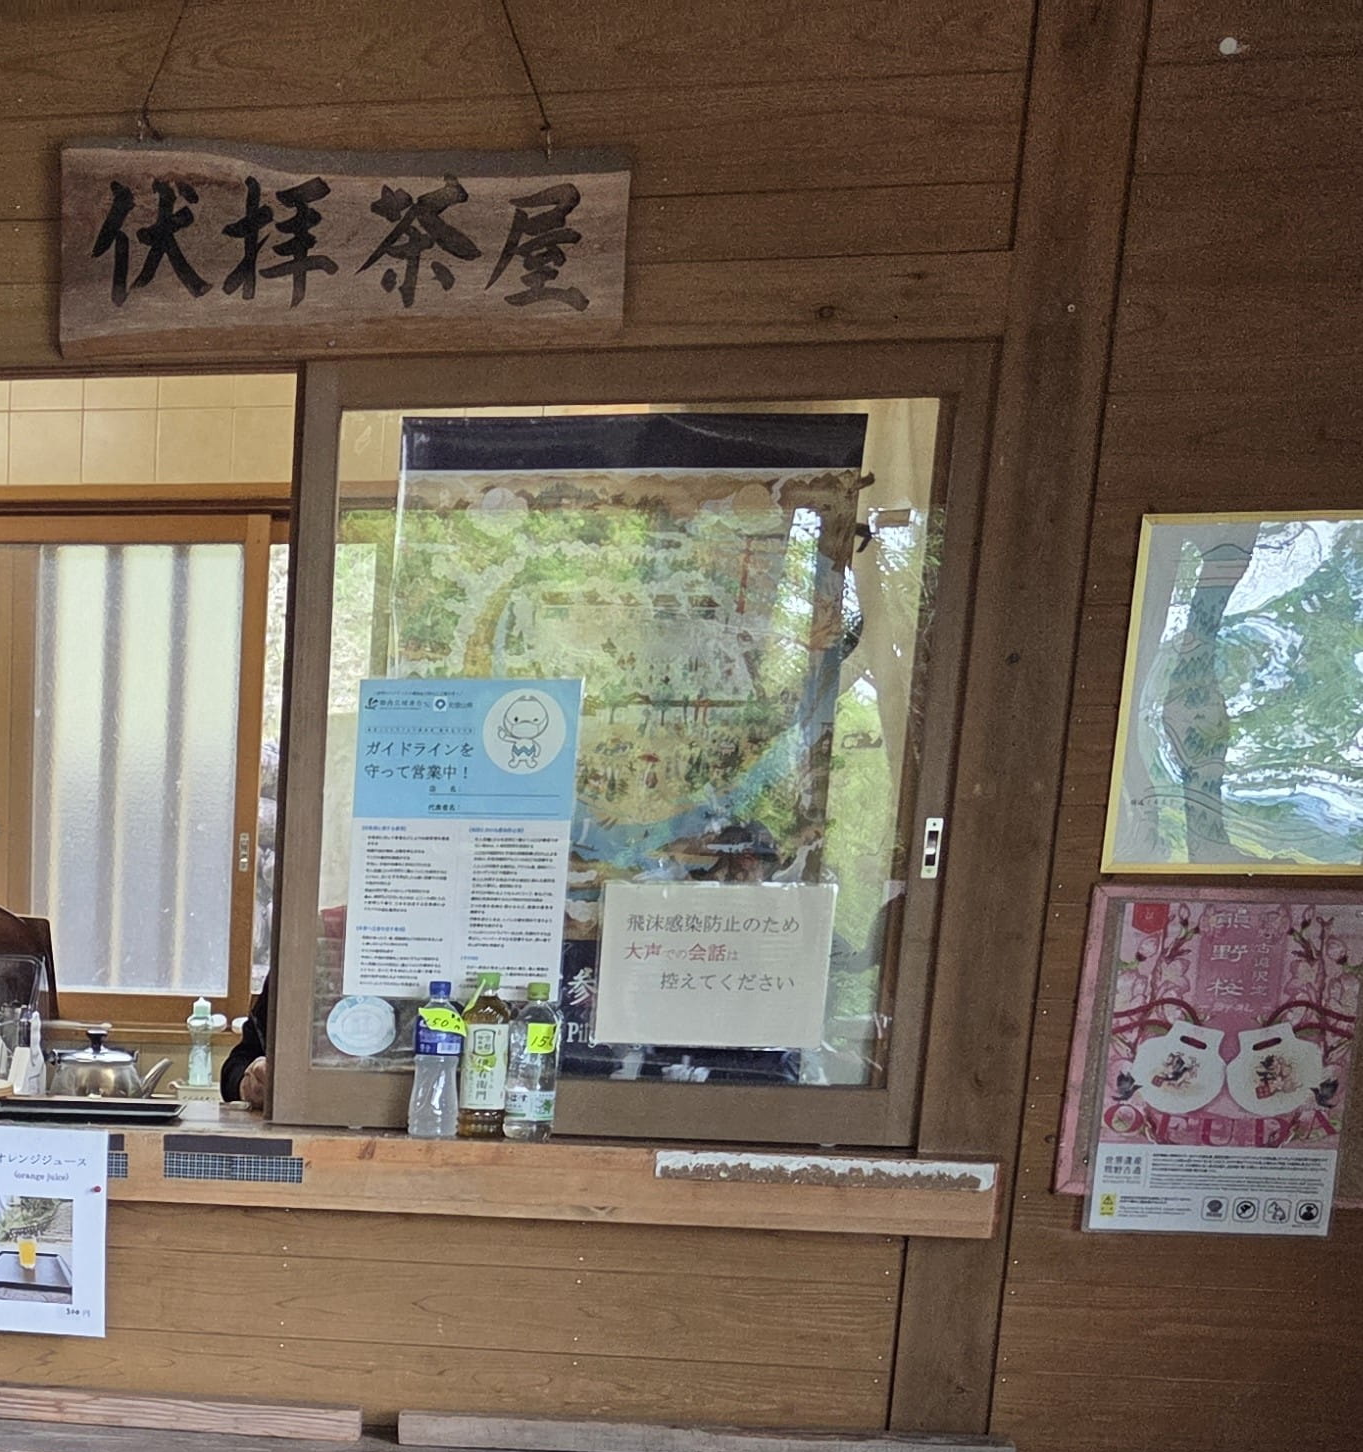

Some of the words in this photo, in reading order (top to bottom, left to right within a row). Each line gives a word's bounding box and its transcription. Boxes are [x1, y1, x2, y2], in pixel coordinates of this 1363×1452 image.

[91, 173, 590, 311] 伏拝茶屋
[365, 741, 474, 757] ガイドラインを
[626, 914, 799, 934] 飛沫感染防止のため
[624, 942, 739, 962] 大声での会話は
[660, 972, 795, 992] 控えてください
